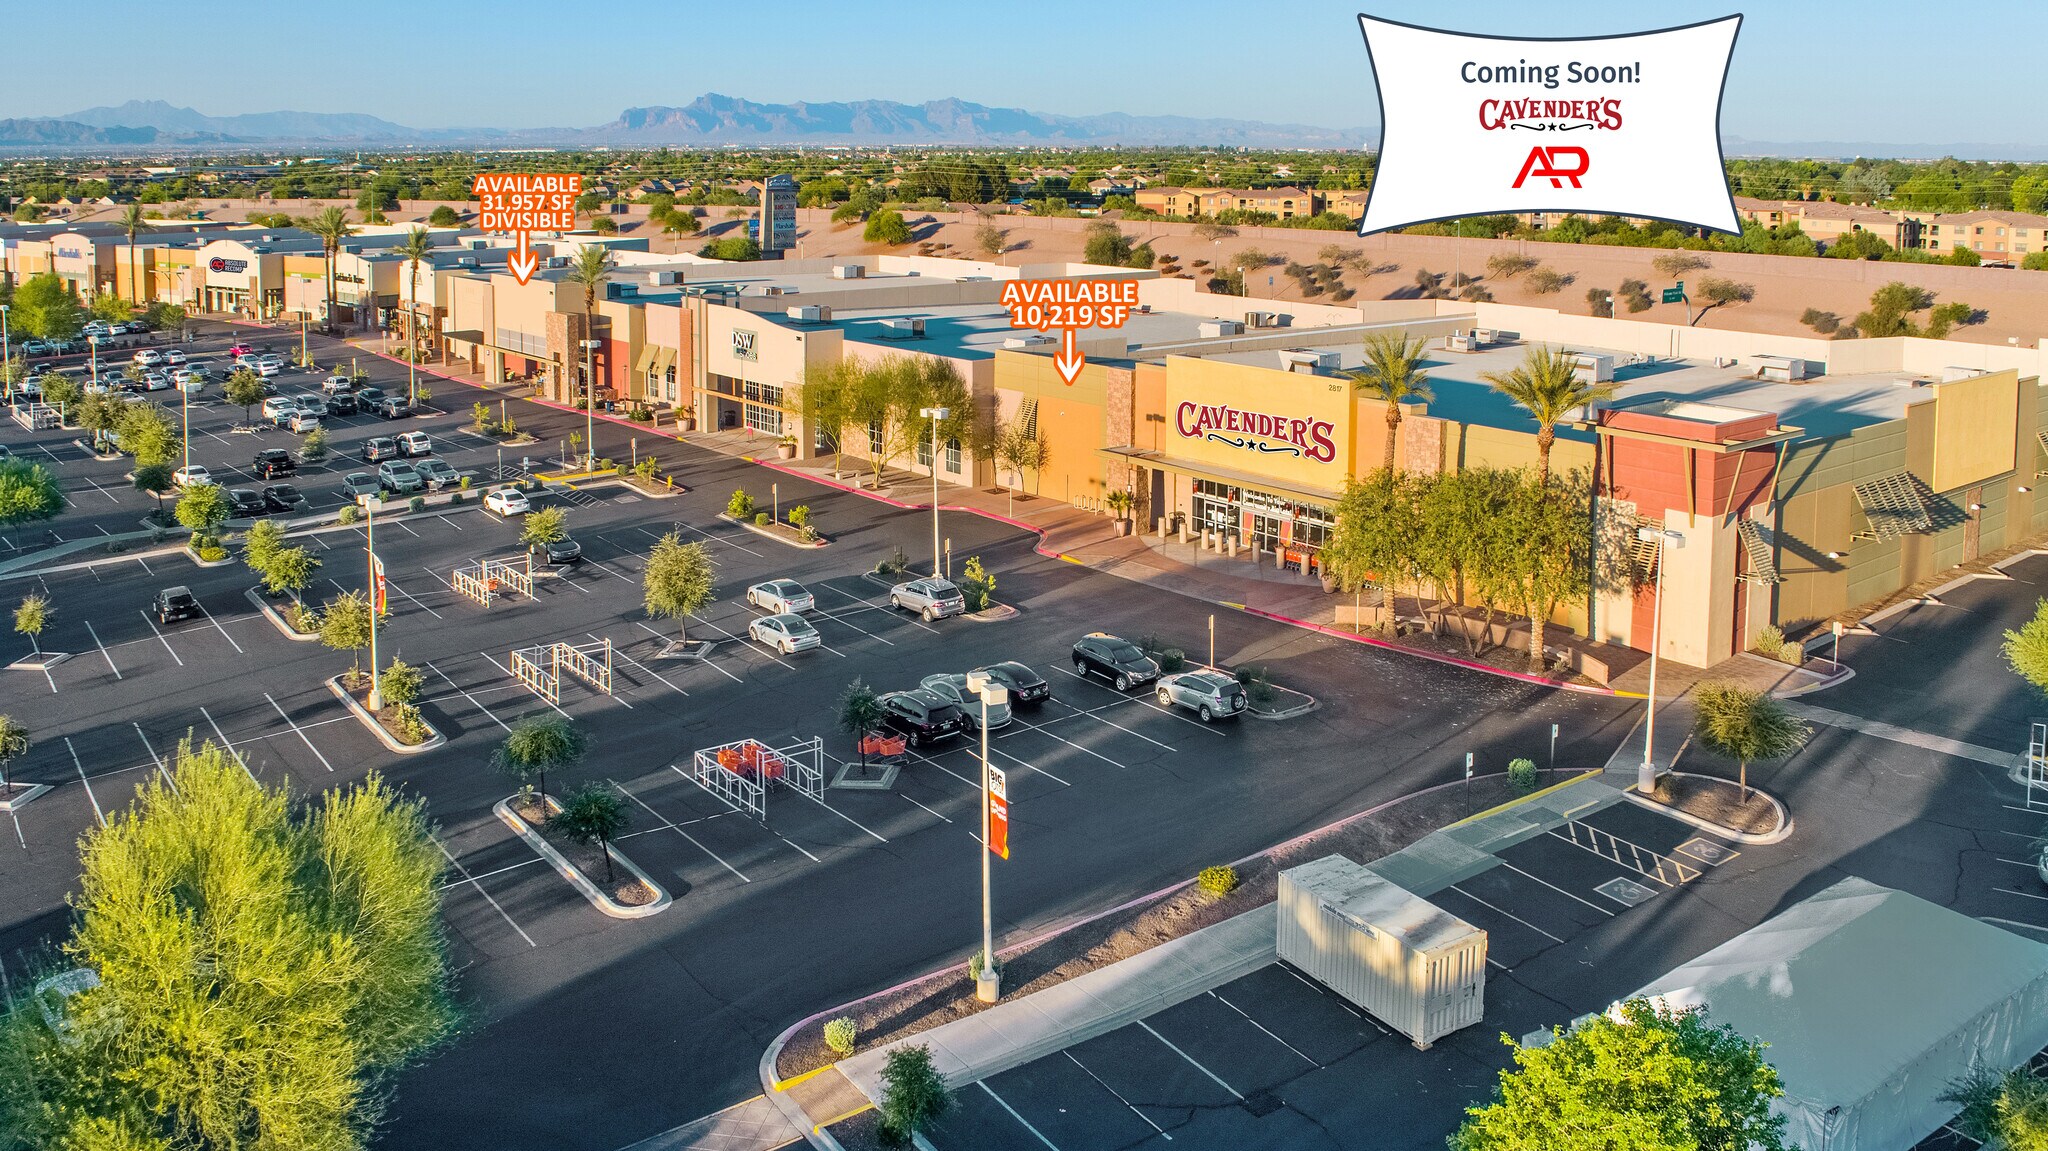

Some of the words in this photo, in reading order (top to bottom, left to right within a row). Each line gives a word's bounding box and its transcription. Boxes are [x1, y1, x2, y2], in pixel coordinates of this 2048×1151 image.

[732, 331, 755, 349] DSW
[1328, 384, 1343, 393] 2817
[1177, 401, 1336, 464] CAVENDER'S
[990, 769, 1003, 785] BIG
